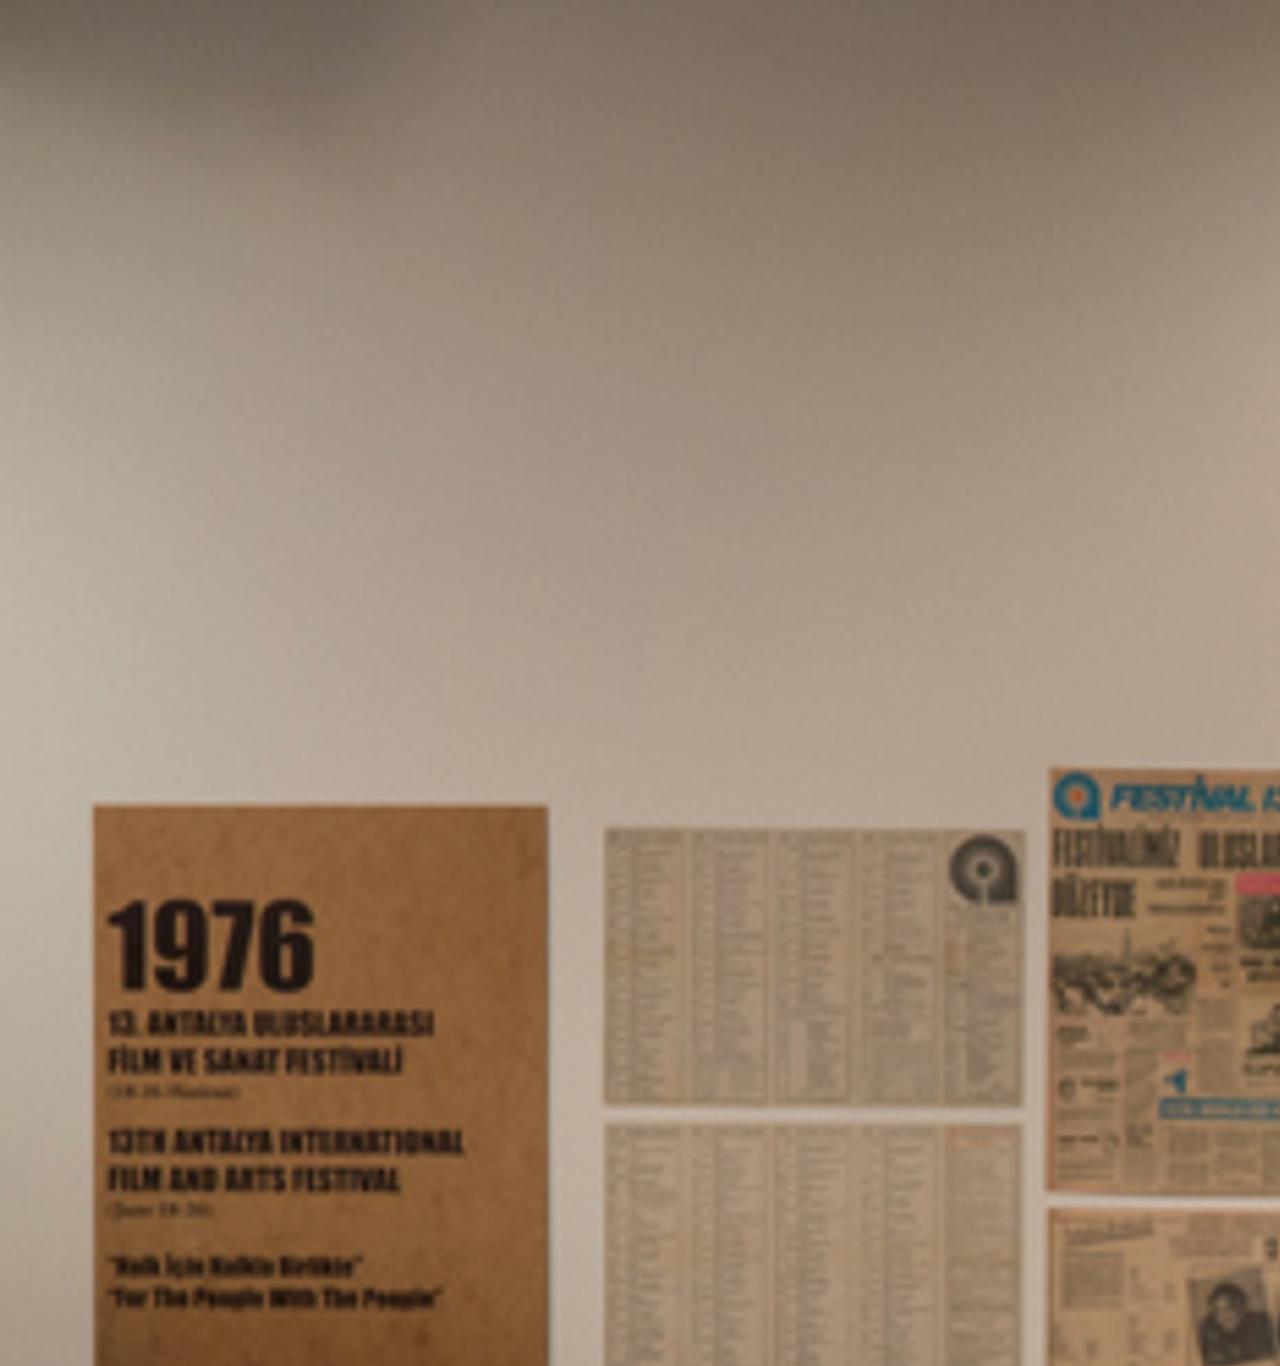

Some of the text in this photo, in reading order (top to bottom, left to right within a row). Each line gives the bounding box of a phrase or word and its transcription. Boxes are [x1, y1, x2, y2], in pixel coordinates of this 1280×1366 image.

[108, 899, 315, 993] 1976
[108, 1010, 434, 1037] 13. ANTALYA ULUSLARARASI
[108, 1044, 403, 1075] FİLM VE SANAT FESTİVALİ
[108, 1130, 466, 1158] 13TH ANTALYA INTERNATIONAL
[108, 1166, 401, 1194] FILM AND ARTS FESTIVAL
[152, 1288, 188, 1309] The
[322, 1288, 358, 1309] The
